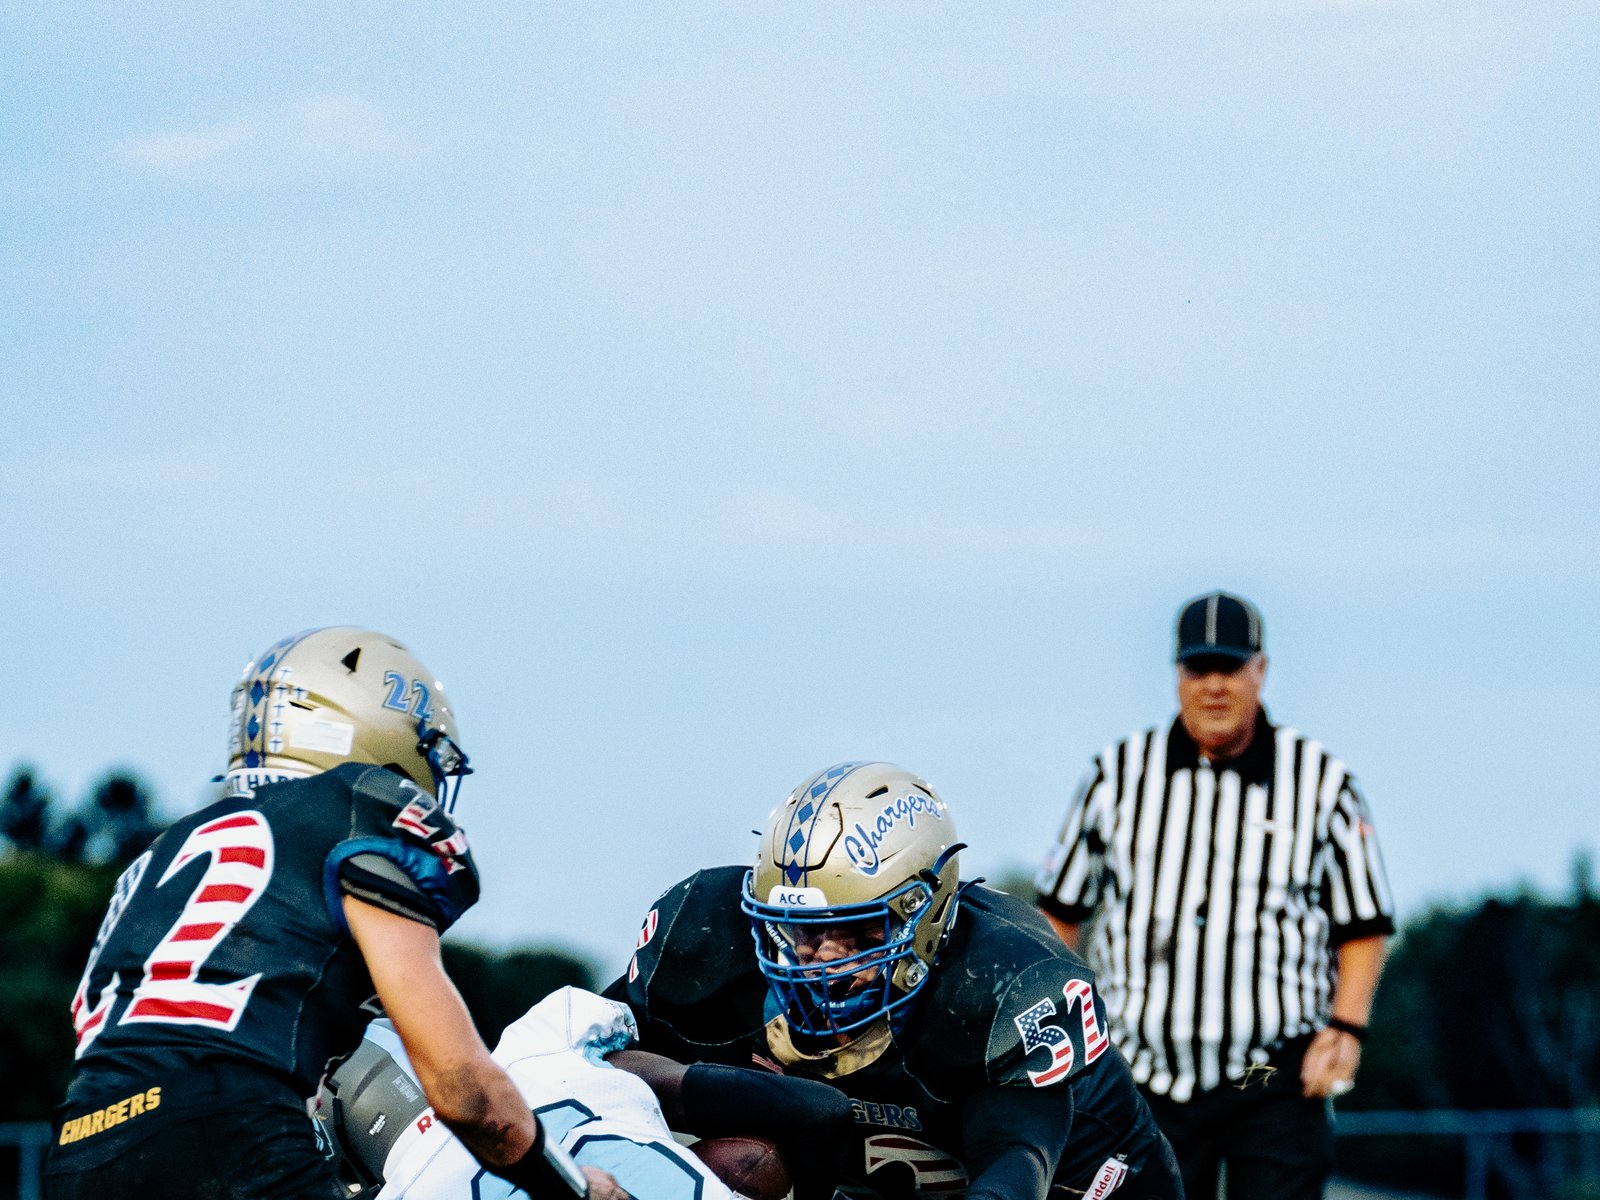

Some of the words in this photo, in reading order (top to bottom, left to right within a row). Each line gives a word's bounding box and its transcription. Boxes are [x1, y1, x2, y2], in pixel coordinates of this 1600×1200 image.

[382, 670, 435, 723] 22
[844, 794, 942, 876] Chargers
[779, 893, 806, 905] ACC
[1014, 979, 1110, 1088] 52
[59, 1086, 161, 1146] CHARGERS
[848, 1098, 923, 1131] GERS
